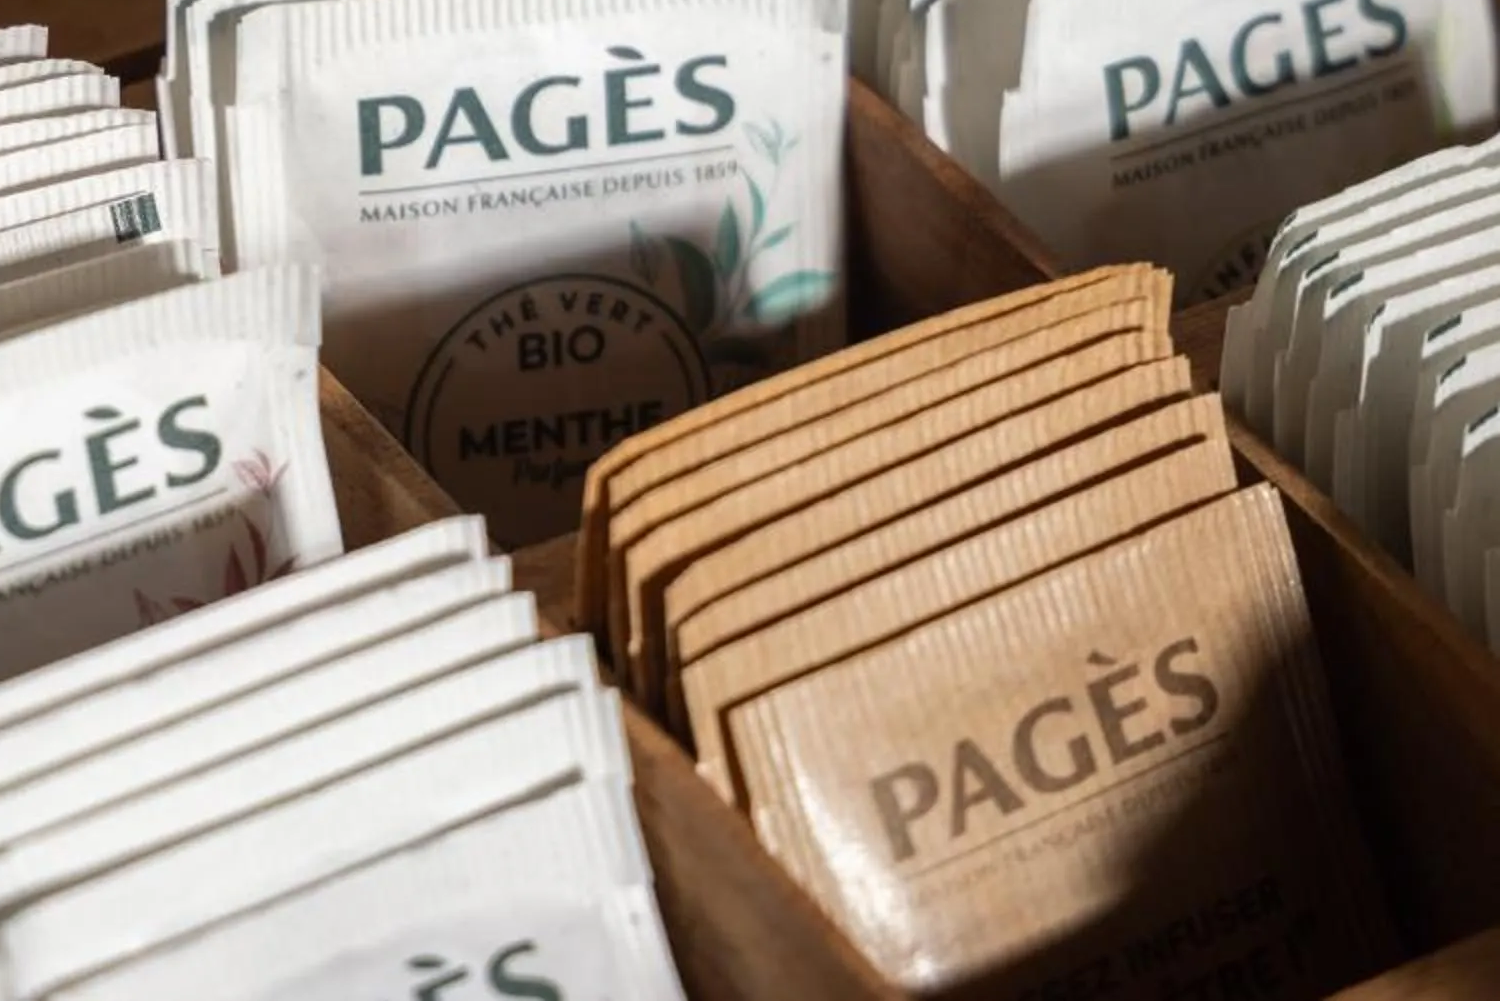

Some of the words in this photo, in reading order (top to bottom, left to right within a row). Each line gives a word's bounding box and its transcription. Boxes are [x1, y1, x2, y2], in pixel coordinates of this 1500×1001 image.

[357, 45, 736, 177] PAGÈS
[359, 197, 459, 224] MAISON
[467, 182, 595, 212] FRANÇAISE
[602, 166, 684, 196] DEPUIS
[693, 158, 739, 183] 1859
[1111, 151, 1194, 188] MAISON
[557, 290, 654, 335] VERT
[518, 324, 606, 372] BIO
[870, 637, 1220, 862] PAGÈS
